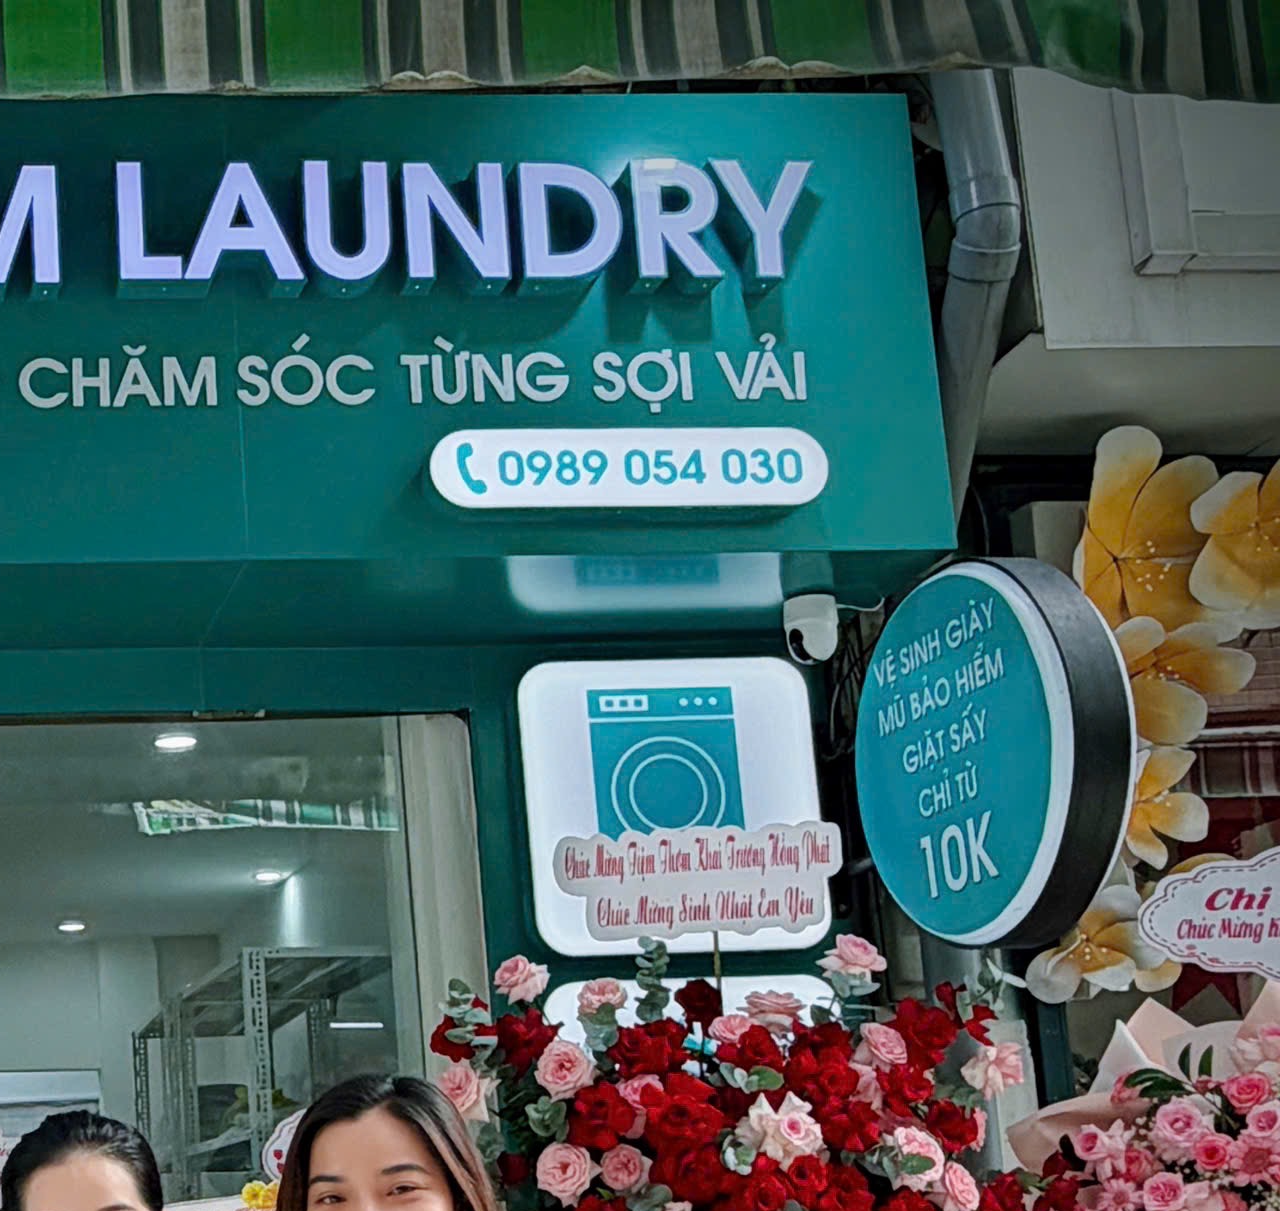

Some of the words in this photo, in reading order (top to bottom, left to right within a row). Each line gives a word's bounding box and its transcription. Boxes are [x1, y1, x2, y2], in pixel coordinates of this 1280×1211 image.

[117, 157, 813, 281] LAUNDRY
[19, 345, 218, 408] CHĂM
[237, 333, 375, 406] SÓC
[400, 335, 569, 404] TỪNG
[592, 348, 693, 414] SỢI
[715, 333, 807, 401] VẢI
[498, 449, 608, 487] 0989
[624, 449, 706, 485] 054
[721, 448, 803, 485] 030
[873, 649, 896, 688] VỆ
[899, 629, 941, 675] SINH
[945, 598, 994, 649] GIÀY
[878, 694, 905, 737] MŨ
[909, 675, 950, 721] BẢO
[955, 642, 1004, 698] HIỂM
[903, 729, 945, 773] GIẶT
[949, 703, 986, 753] SẤY
[919, 768, 952, 817] CHỈ
[955, 760, 978, 800] TỪ
[920, 810, 999, 899] 10K
[679, 893, 710, 922] Sinh
[1177, 916, 1216, 940] Chúc
[1218, 915, 1264, 944] Mừng
[1205, 886, 1273, 917] Chị
